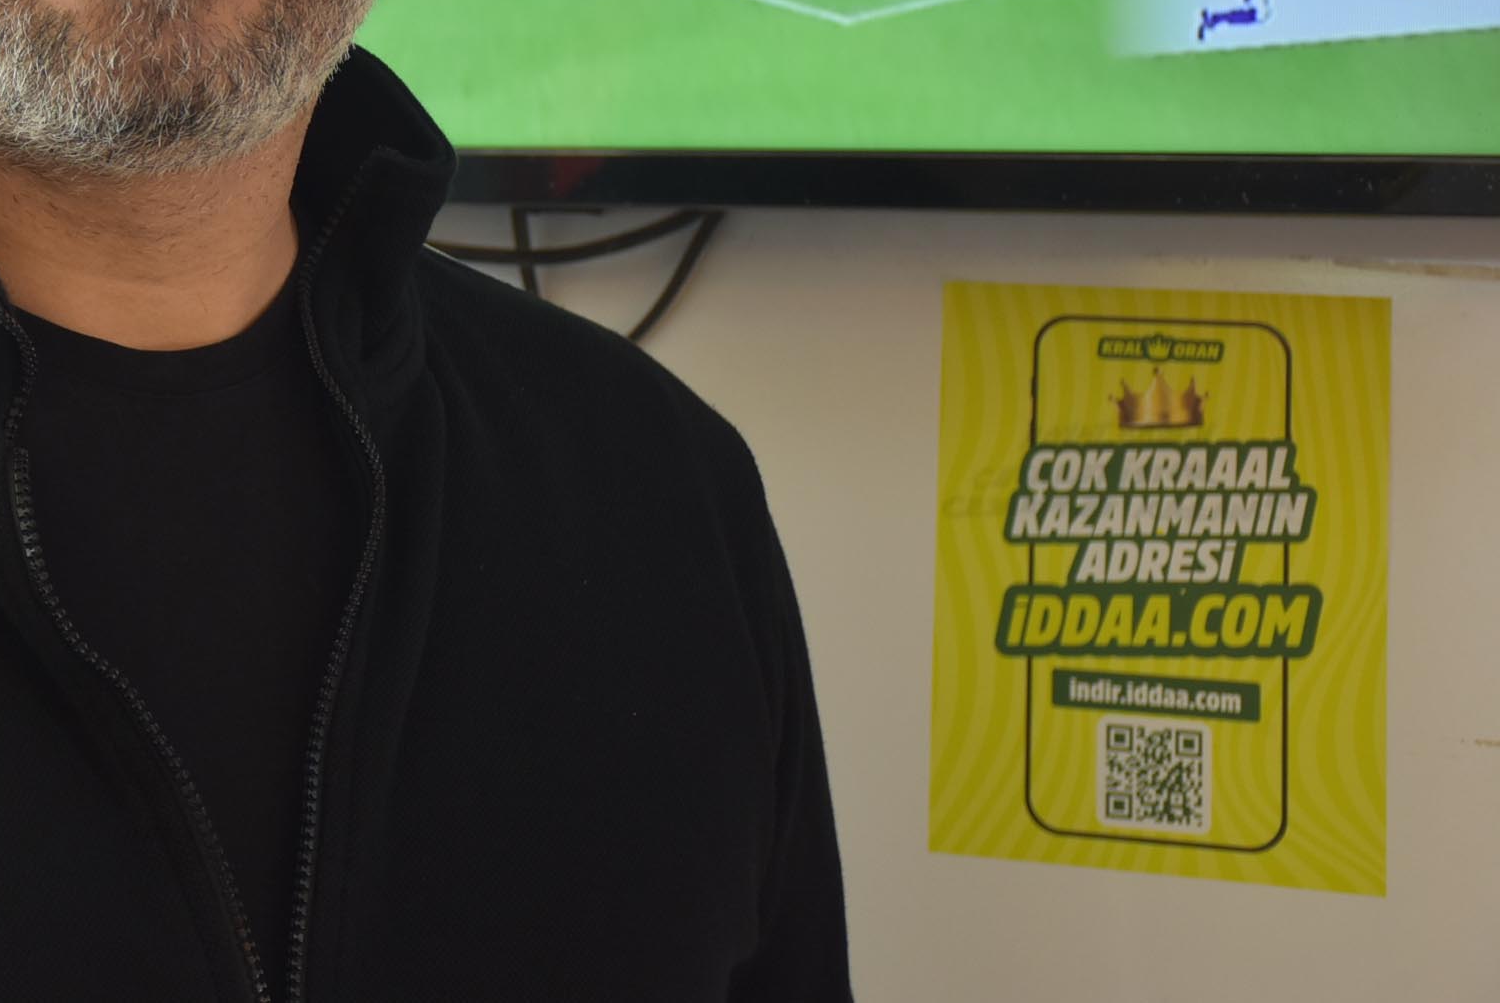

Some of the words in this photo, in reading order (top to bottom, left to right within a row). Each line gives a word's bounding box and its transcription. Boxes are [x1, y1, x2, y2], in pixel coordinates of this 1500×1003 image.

[1101, 339, 1143, 356] KRAL
[1026, 448, 1115, 503] ÇOK
[1118, 446, 1291, 490] KRAAAL
[1011, 493, 1308, 538] KAZANMANIN
[1069, 676, 1242, 715] indir.iddaa.com
